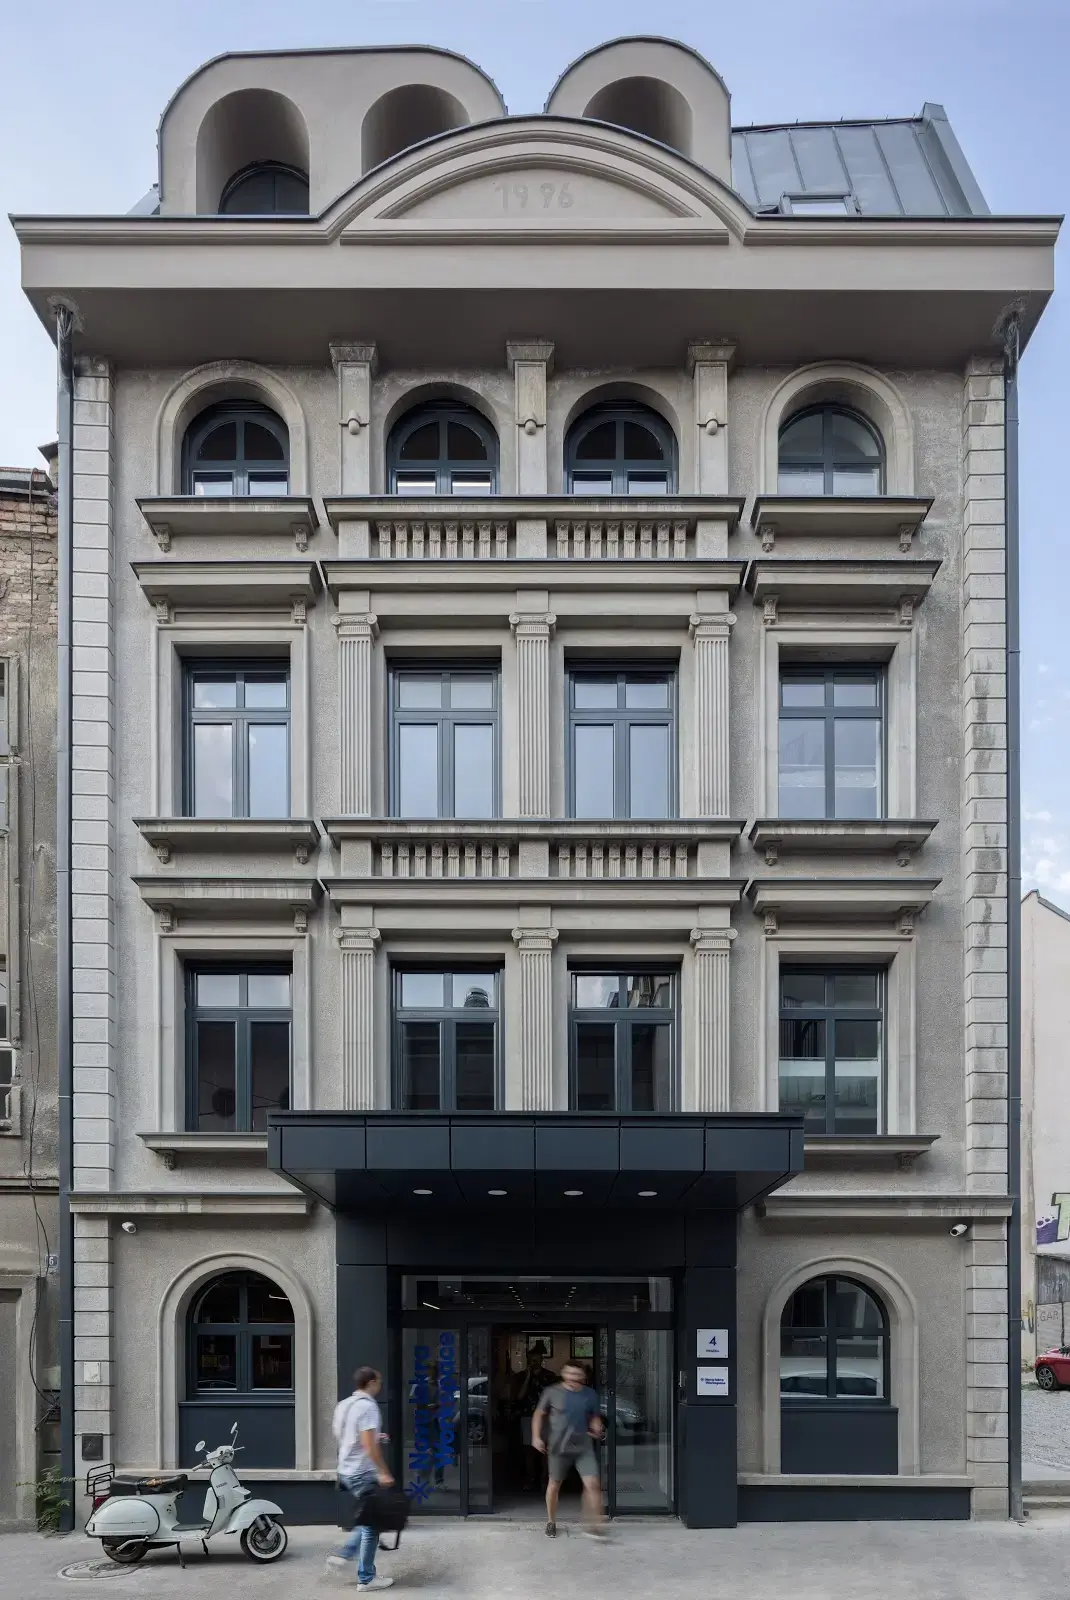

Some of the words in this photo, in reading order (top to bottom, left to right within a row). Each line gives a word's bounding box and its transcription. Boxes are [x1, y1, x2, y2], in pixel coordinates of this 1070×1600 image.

[709, 1336, 717, 1346] 4
[435, 1332, 457, 1468] Workspace
[409, 1408, 429, 1471] Nova
